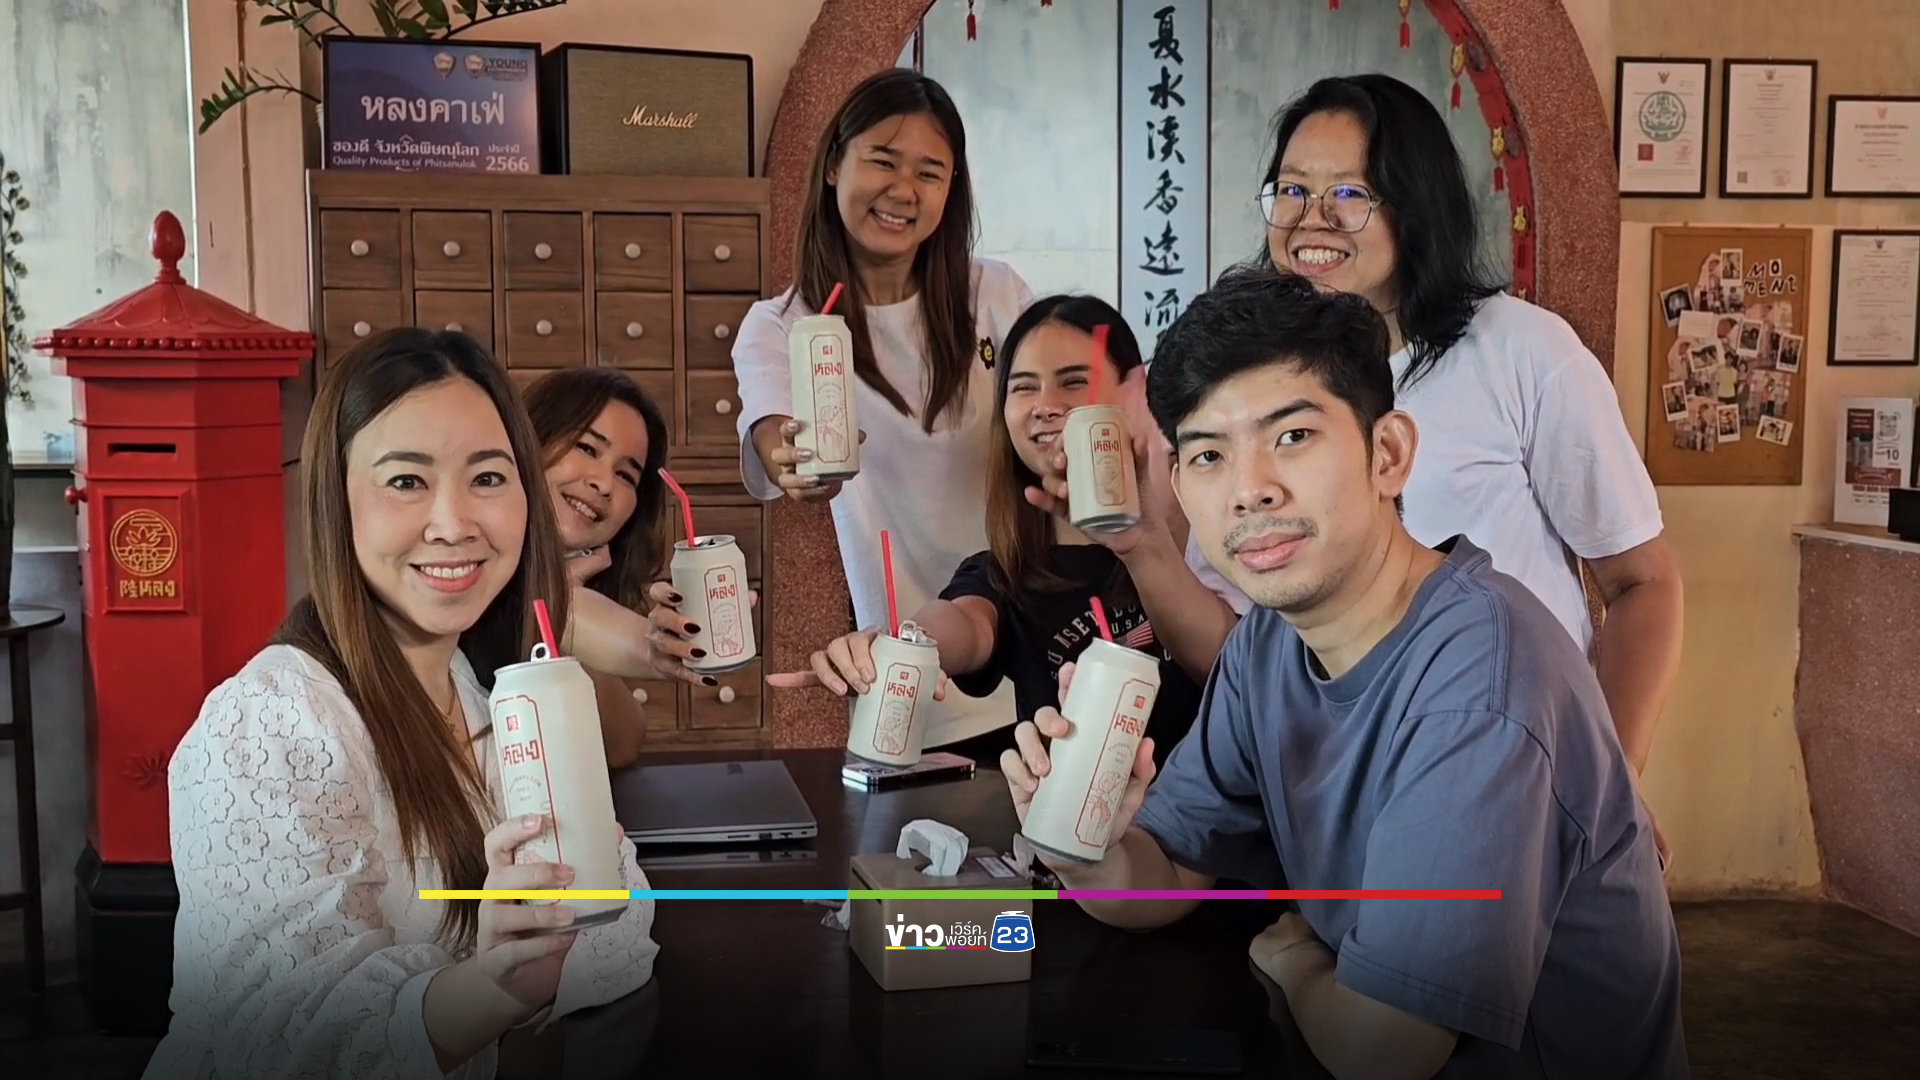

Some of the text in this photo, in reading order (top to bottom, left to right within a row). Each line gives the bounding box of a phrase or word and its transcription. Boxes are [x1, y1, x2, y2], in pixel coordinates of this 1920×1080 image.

[488, 57, 527, 70] YOUNG
[361, 91, 504, 125] หลงคาเฟ่
[622, 105, 698, 129] Marshall
[332, 138, 480, 159] ของดี จังหวัดพิษณุโลก
[332, 155, 477, 170] Quality Products of Phitsanulok
[485, 155, 529, 172] 2566
[1886, 449, 1900, 460] 10
